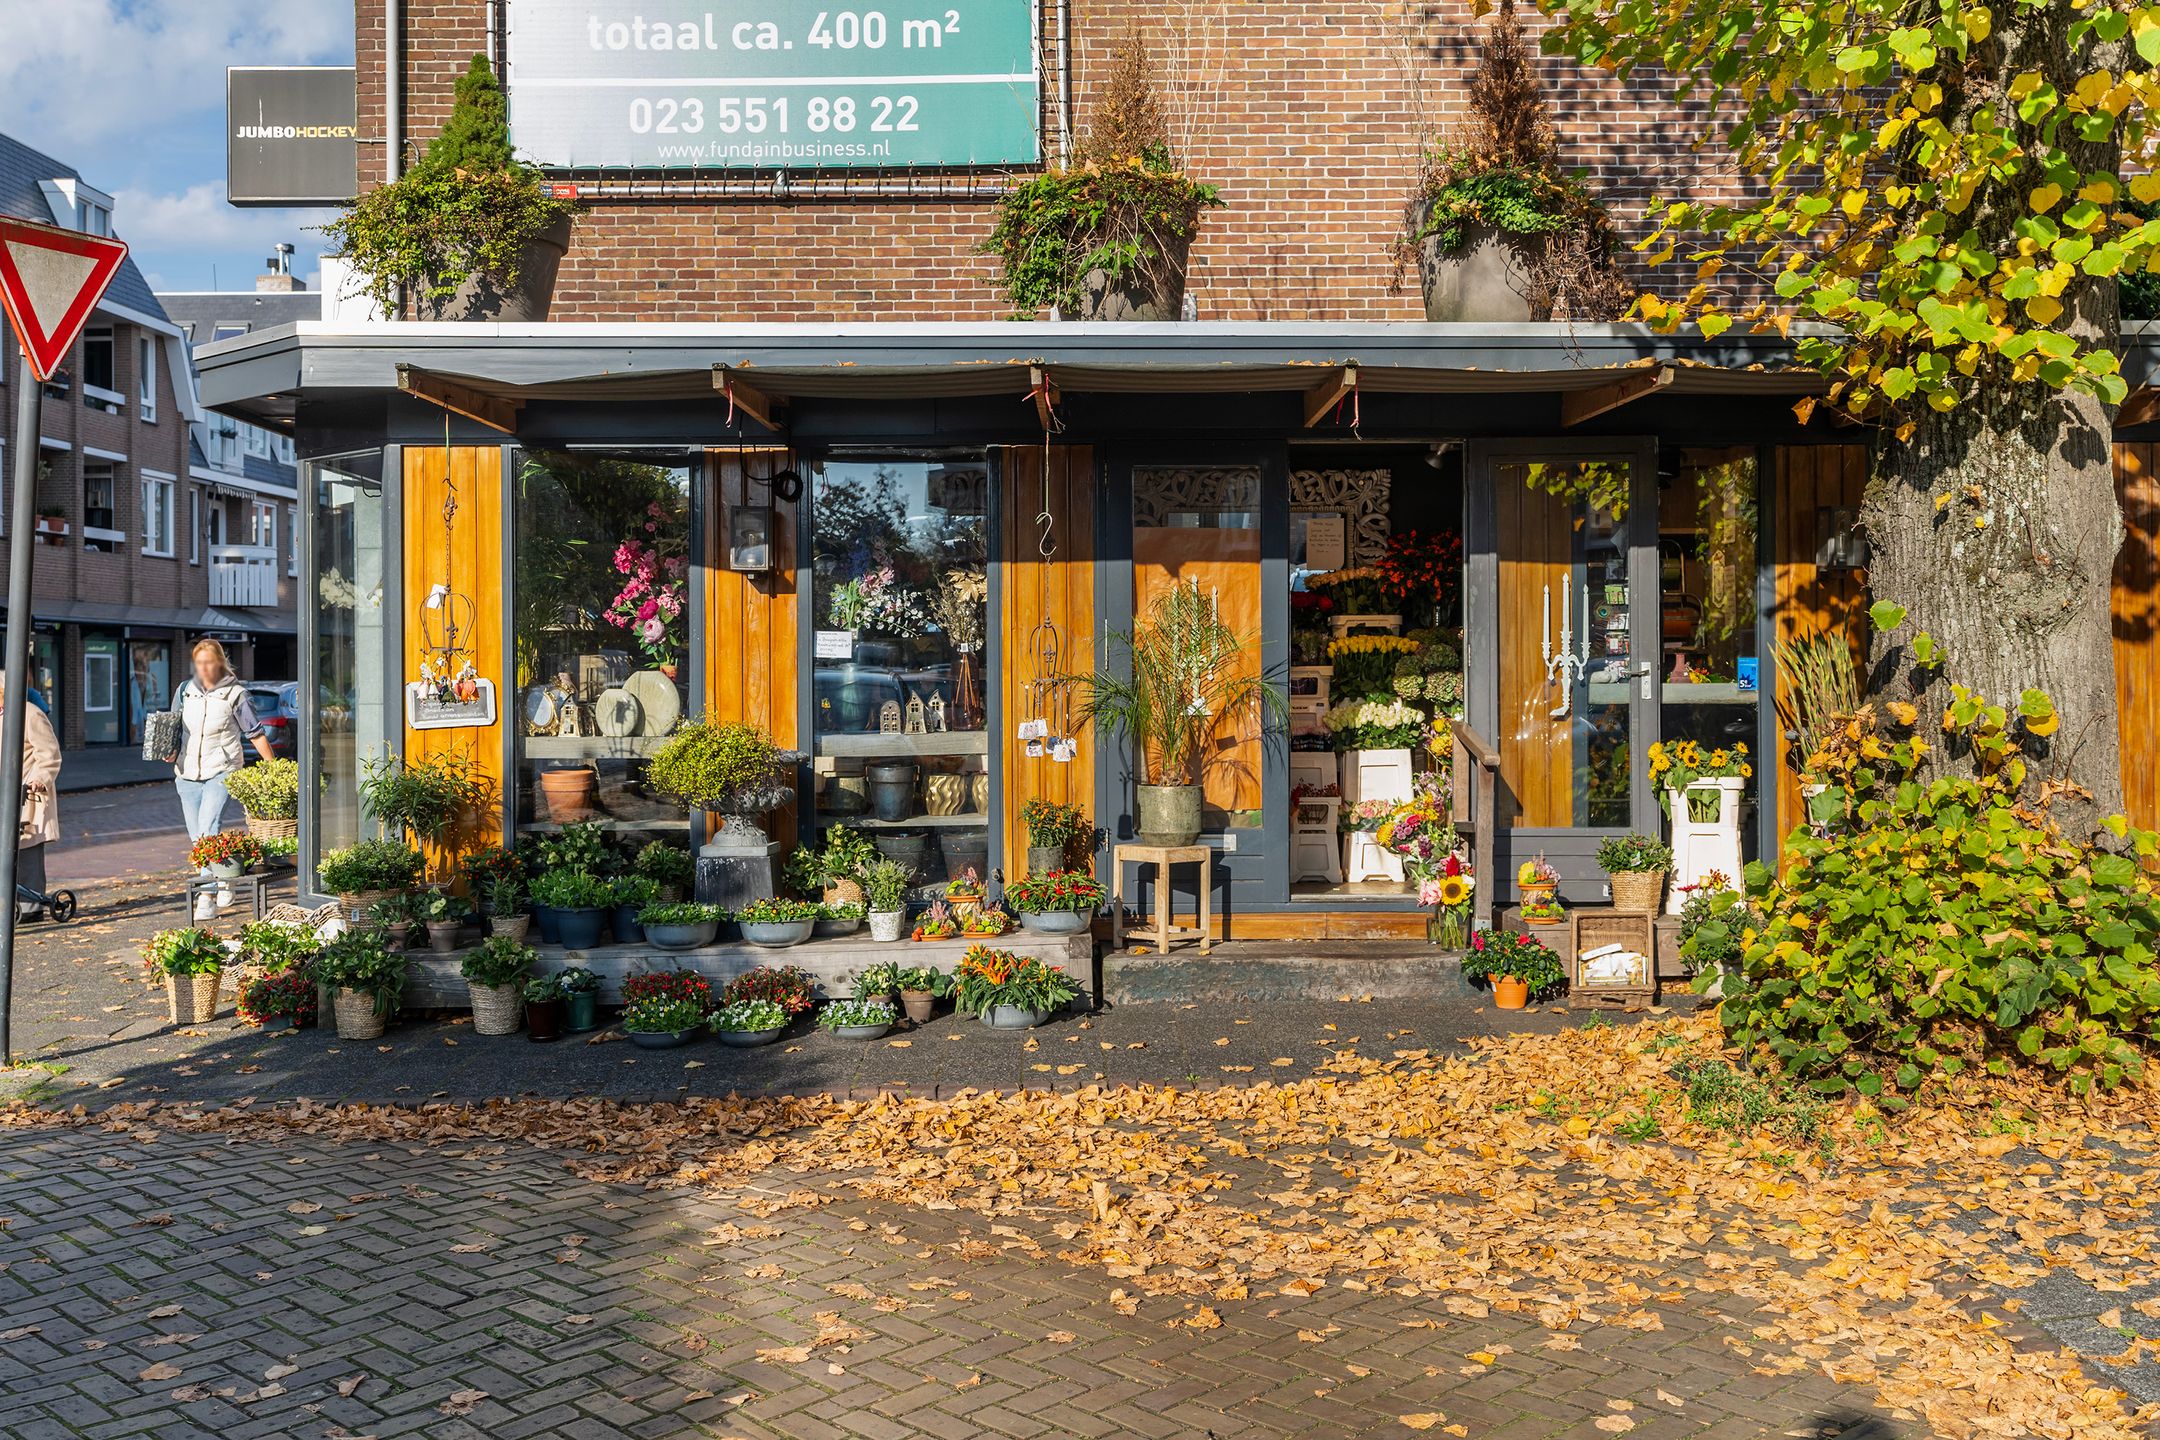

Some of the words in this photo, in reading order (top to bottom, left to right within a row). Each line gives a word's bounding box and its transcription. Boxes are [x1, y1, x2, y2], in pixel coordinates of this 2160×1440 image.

[587, 13, 718, 50] totaal
[732, 21, 793, 50] ca.
[807, 11, 887, 49] 400
[902, 10, 960, 48] m²
[629, 97, 705, 134] 023
[719, 97, 788, 133] 551
[807, 96, 857, 133] 88
[870, 95, 919, 132] 22
[658, 139, 891, 158] www.fundainbusiness.nl
